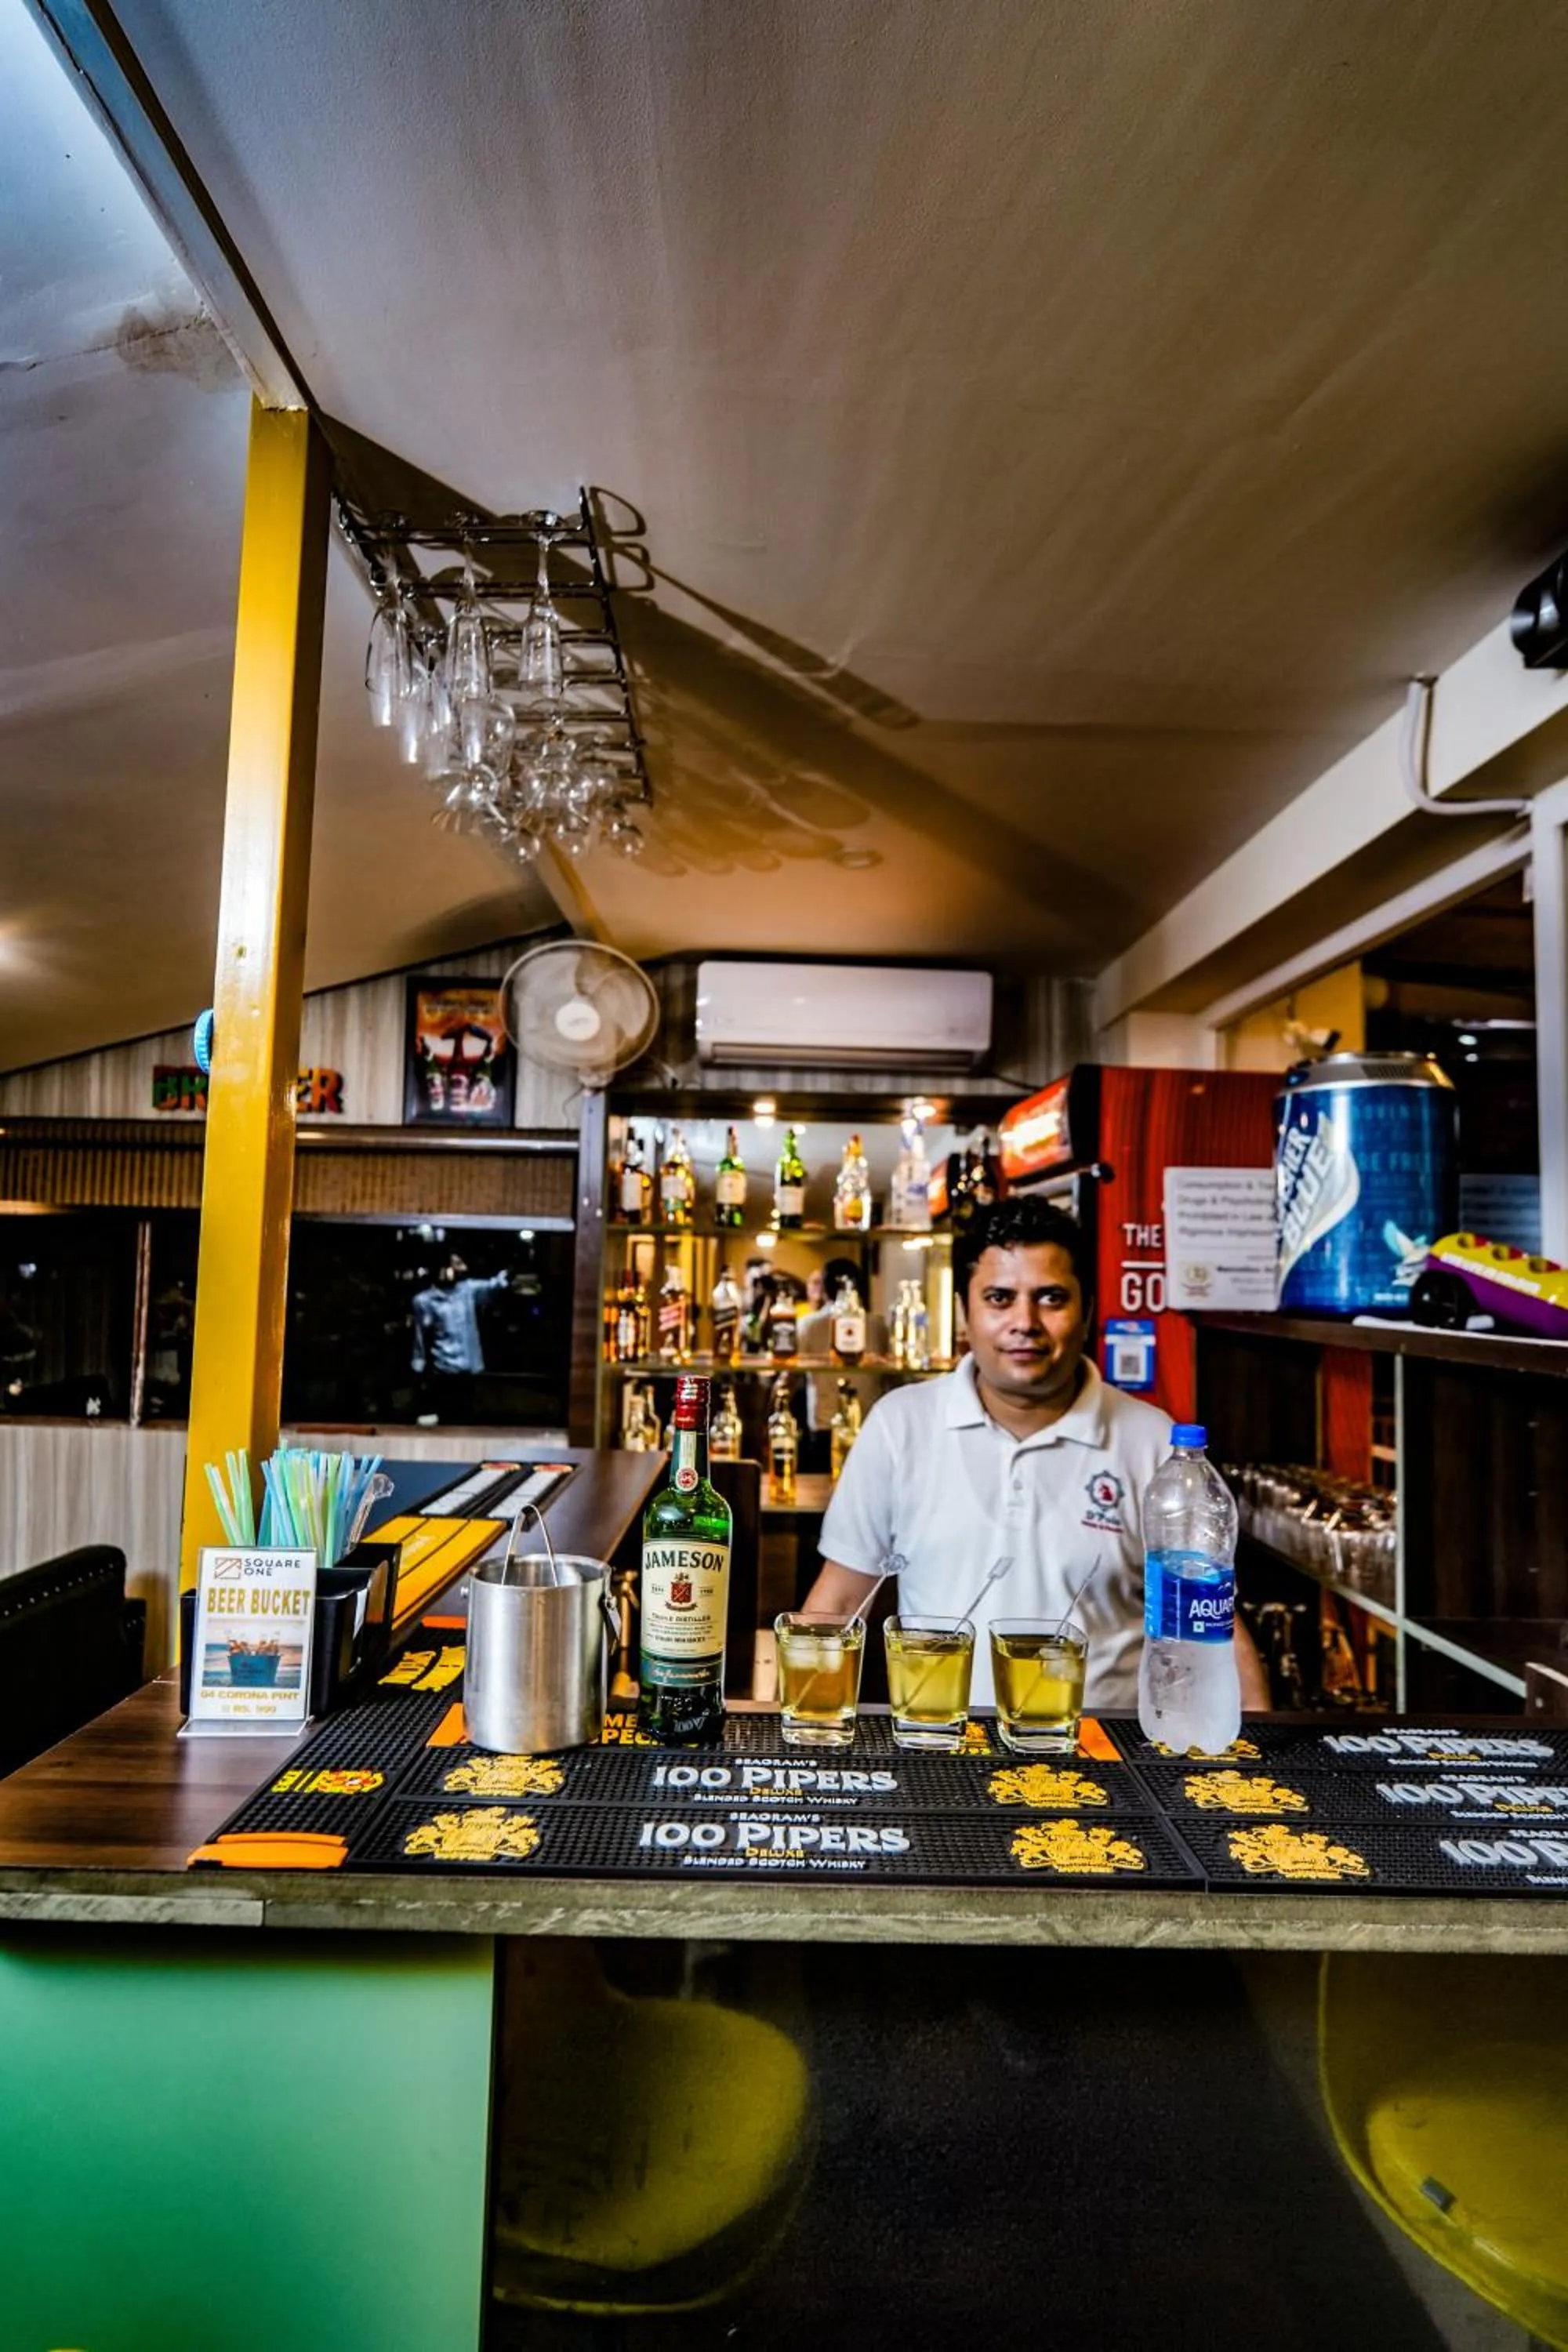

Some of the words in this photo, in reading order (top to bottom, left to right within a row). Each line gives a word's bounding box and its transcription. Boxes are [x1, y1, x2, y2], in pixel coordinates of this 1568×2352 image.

[1282, 1136, 1334, 1251] BLUE
[1122, 1223, 1163, 1247] THE
[244, 1558, 301, 1569] SQUARE
[244, 1567, 272, 1577] ONE
[644, 1550, 724, 1572] JAMESON
[207, 1588, 246, 1613] BEER
[250, 1589, 310, 1615] BUCKET
[218, 1690, 268, 1700] CORONA
[271, 1691, 299, 1700] PINT
[1323, 1735, 1402, 1754] 100
[1396, 1735, 1555, 1758] PIPERS
[735, 1758, 818, 1767] SEAGRAM'S
[653, 1766, 731, 1788] 100
[741, 1766, 898, 1793] PIPERS
[1376, 1784, 1465, 1804] 100
[1457, 1783, 1568, 1807] PIPE
[729, 1812, 821, 1823] SEAGRAM'S
[640, 1821, 727, 1849] 100
[737, 1821, 911, 1853] PIPERS
[1439, 1840, 1539, 1866] 100
